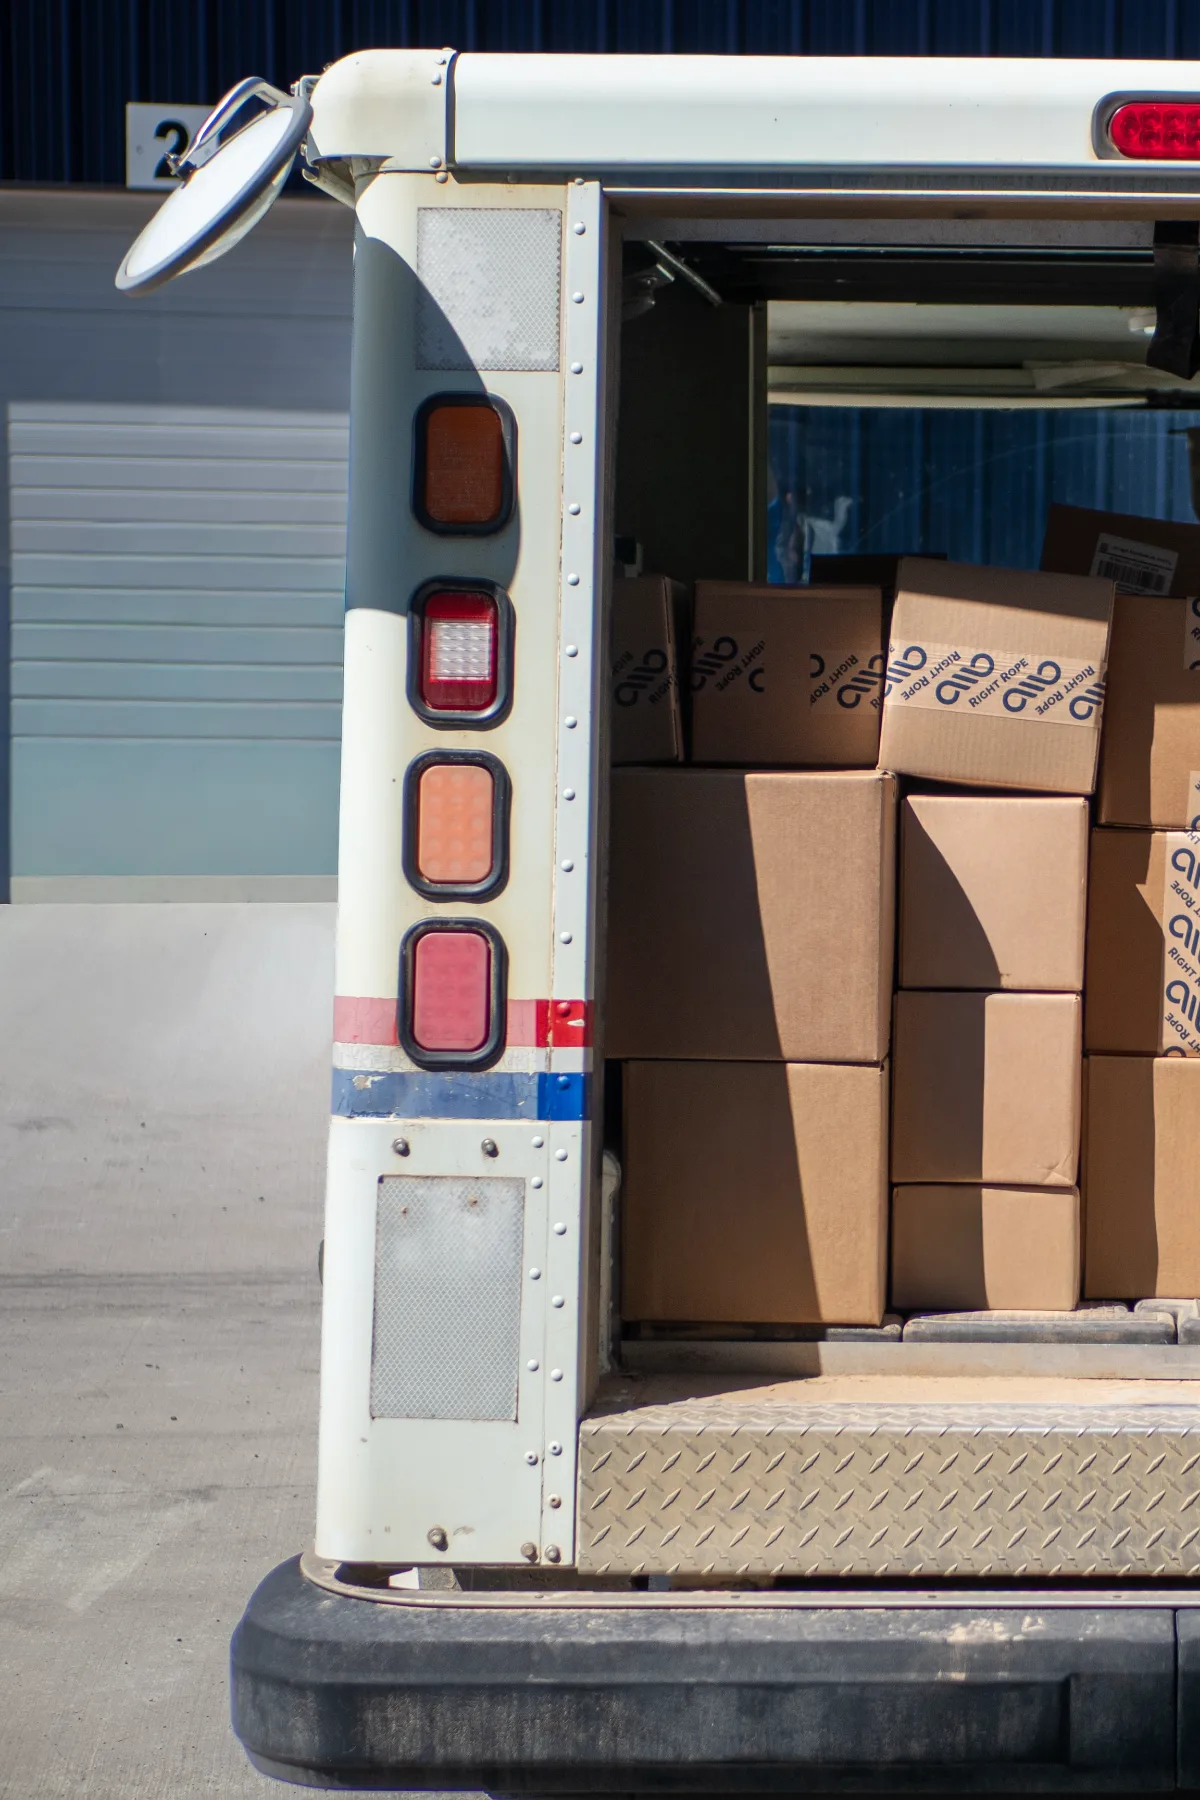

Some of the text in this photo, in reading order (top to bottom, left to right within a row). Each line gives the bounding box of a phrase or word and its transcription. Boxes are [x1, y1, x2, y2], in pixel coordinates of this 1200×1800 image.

[154, 118, 189, 180] 2
[741, 640, 766, 668] IGHT
[900, 650, 962, 701] RIGHT ROPE
[810, 654, 859, 707] RIGHT ROP
[968, 657, 1030, 708] RIGHT ROPE
[1034, 665, 1096, 716] RIGHT ROPE
[1169, 879, 1196, 909] ROPE
[1167, 946, 1197, 977] RIGHT
[1164, 1012, 1191, 1041] ROPE
